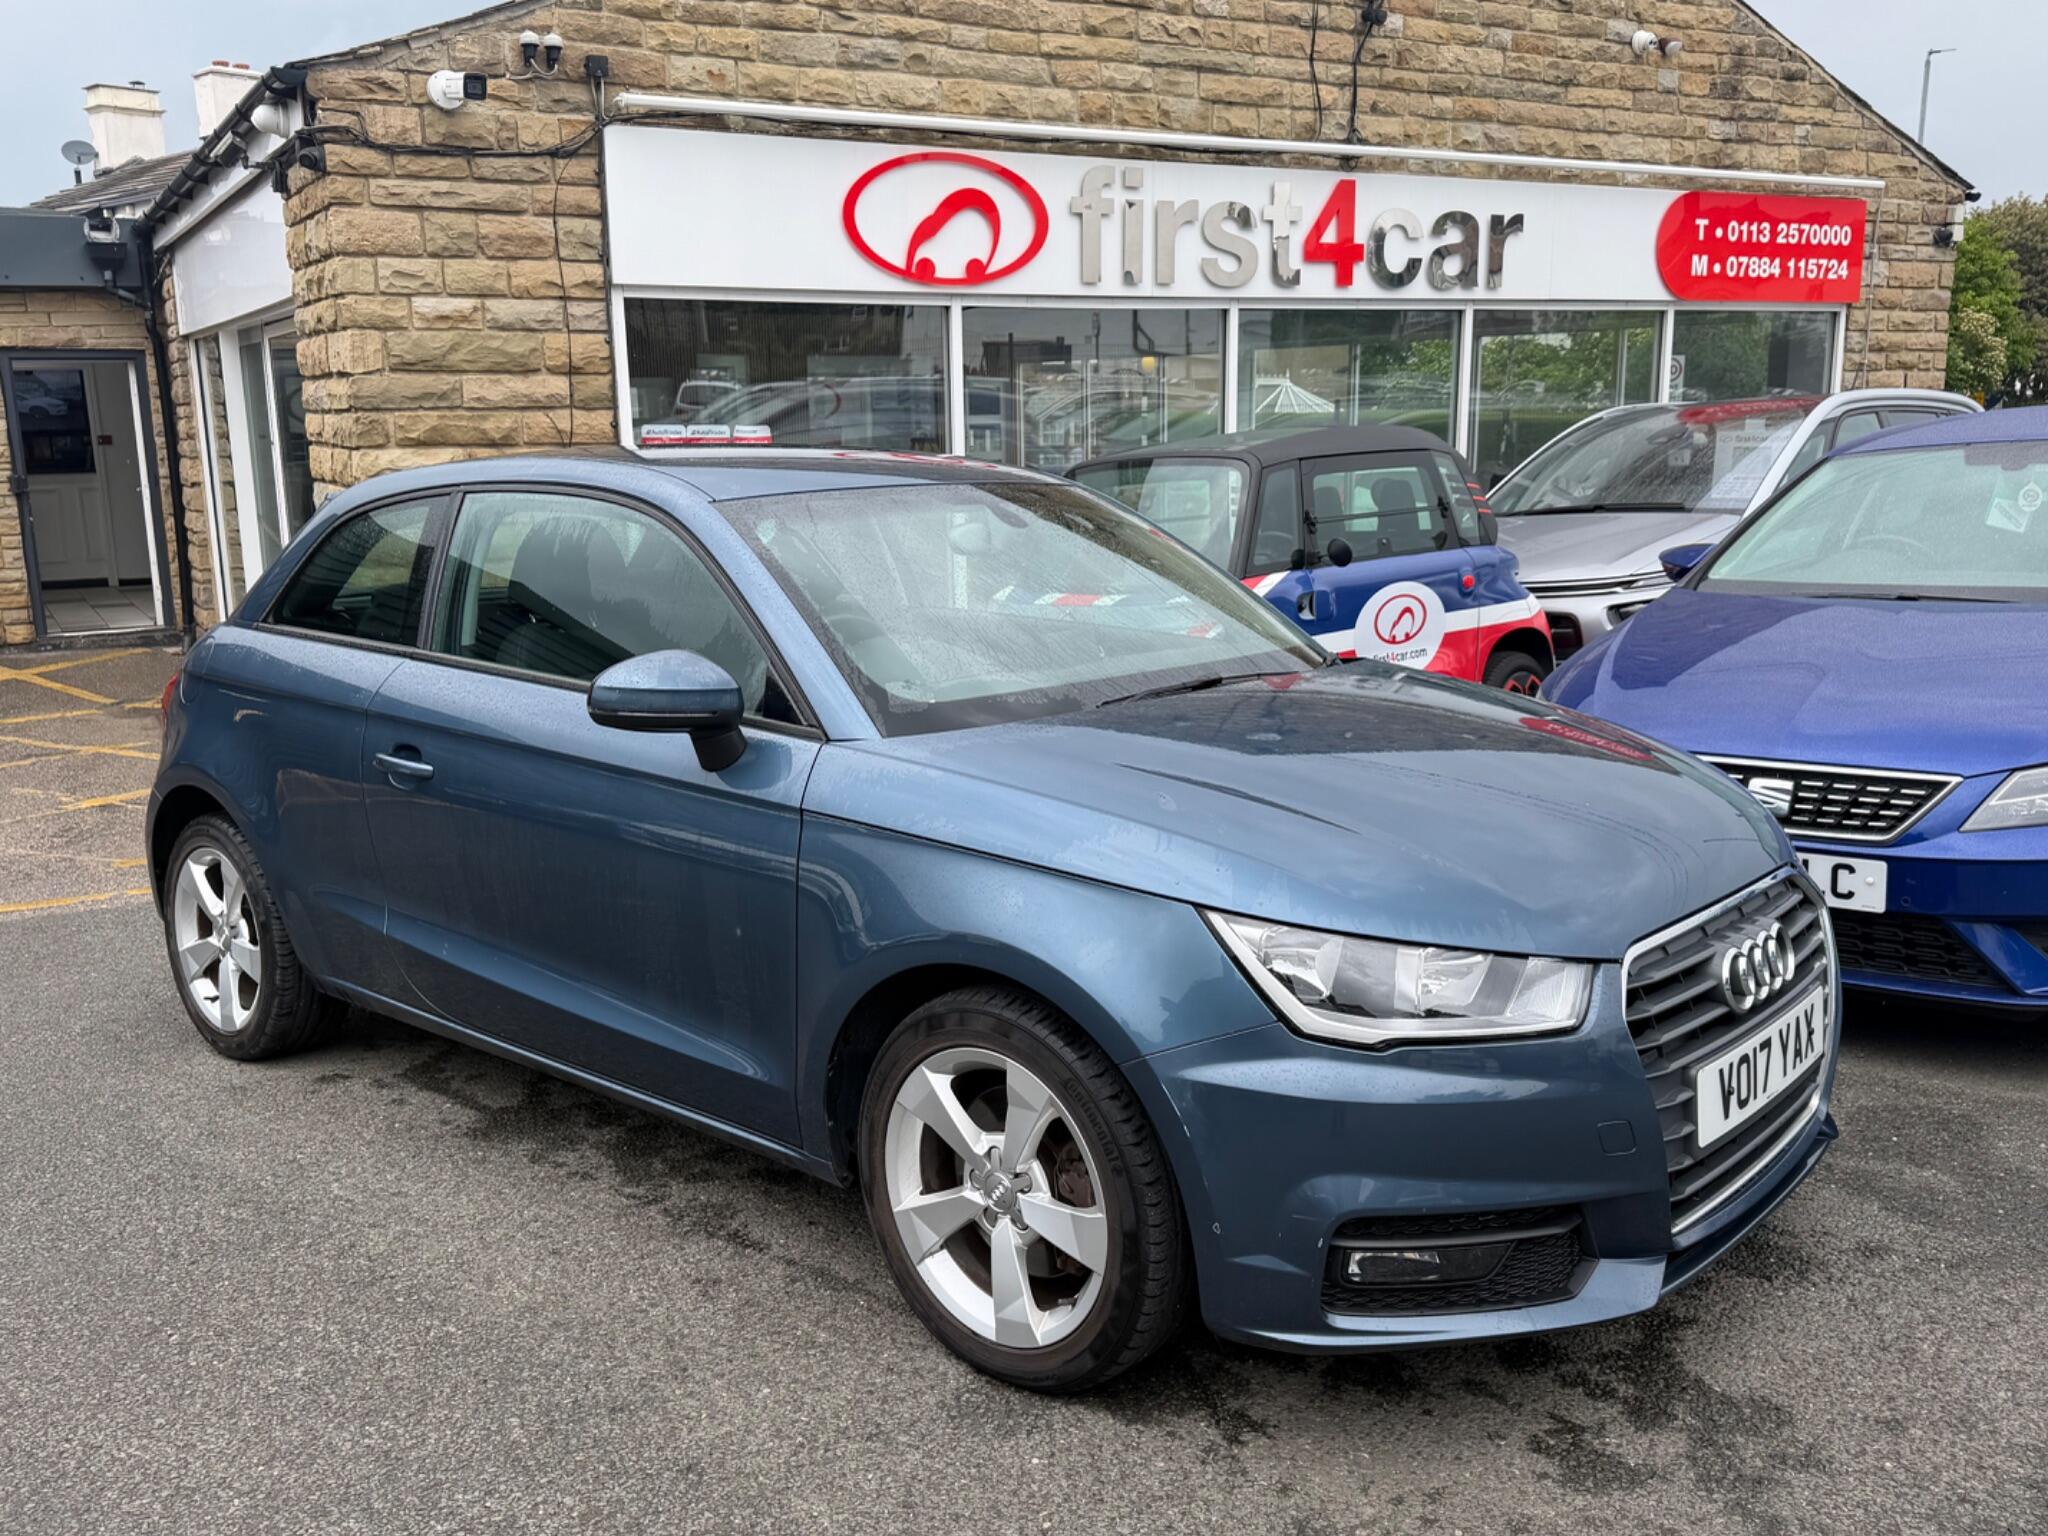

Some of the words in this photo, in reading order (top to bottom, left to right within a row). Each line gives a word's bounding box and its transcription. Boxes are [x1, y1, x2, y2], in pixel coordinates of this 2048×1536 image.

[1071, 165, 1525, 290] first4car
[1695, 218, 1709, 241] T
[1727, 220, 1770, 243] 0113
[1776, 223, 1852, 246] 2570000
[1690, 254, 1708, 277] M
[1726, 255, 1781, 278] 07884
[1787, 258, 1848, 279] 115724
[1719, 1036, 1772, 1121] VO17
[1779, 1003, 1814, 1078] YAX
